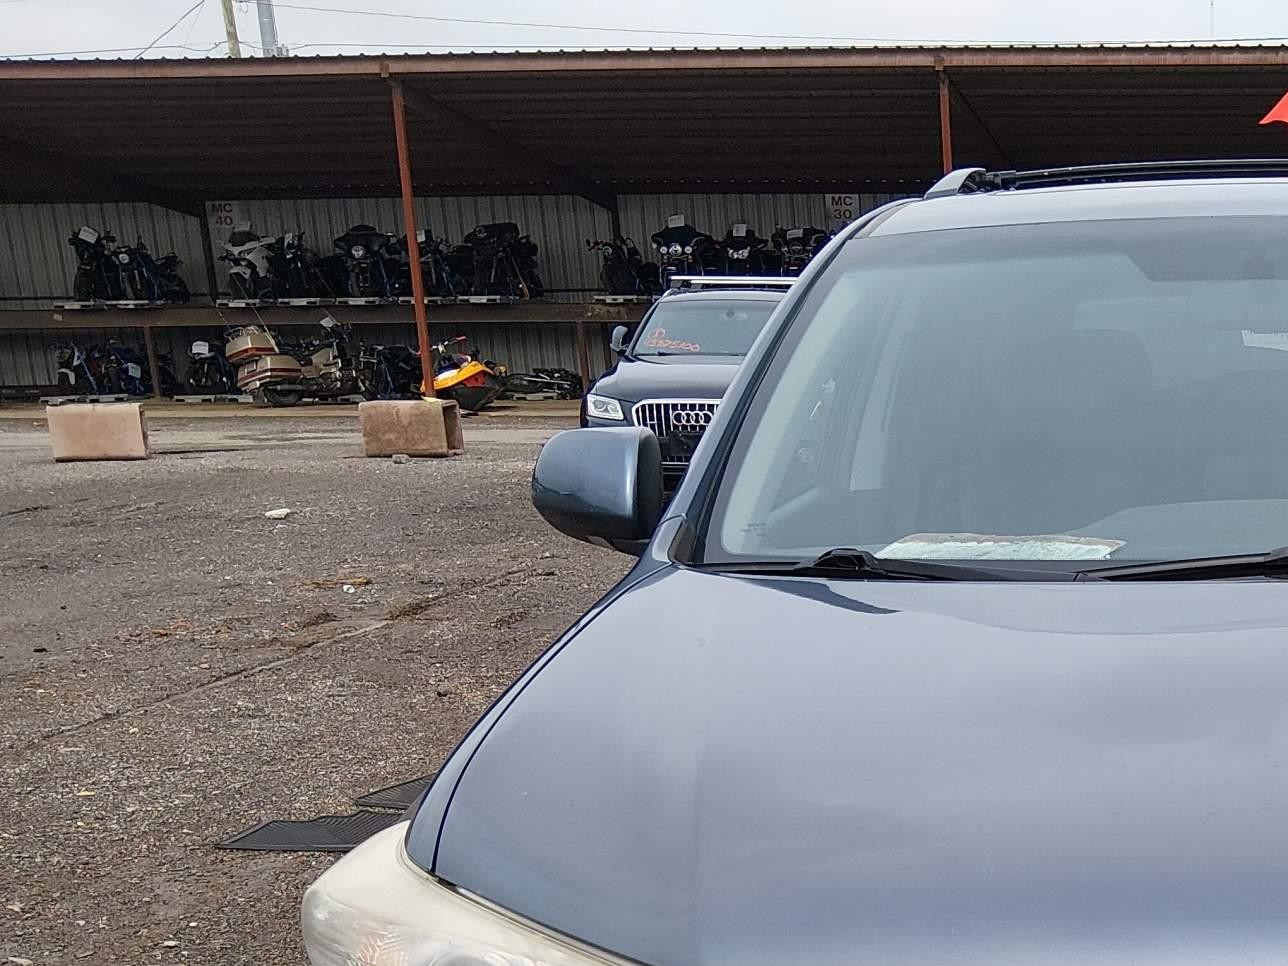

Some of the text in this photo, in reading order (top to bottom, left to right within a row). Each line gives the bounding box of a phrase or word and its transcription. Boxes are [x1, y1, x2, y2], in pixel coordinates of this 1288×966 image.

[831, 196, 853, 206] MC
[211, 203, 233, 213] MC
[833, 209, 853, 219] 30
[215, 216, 233, 226] 40
